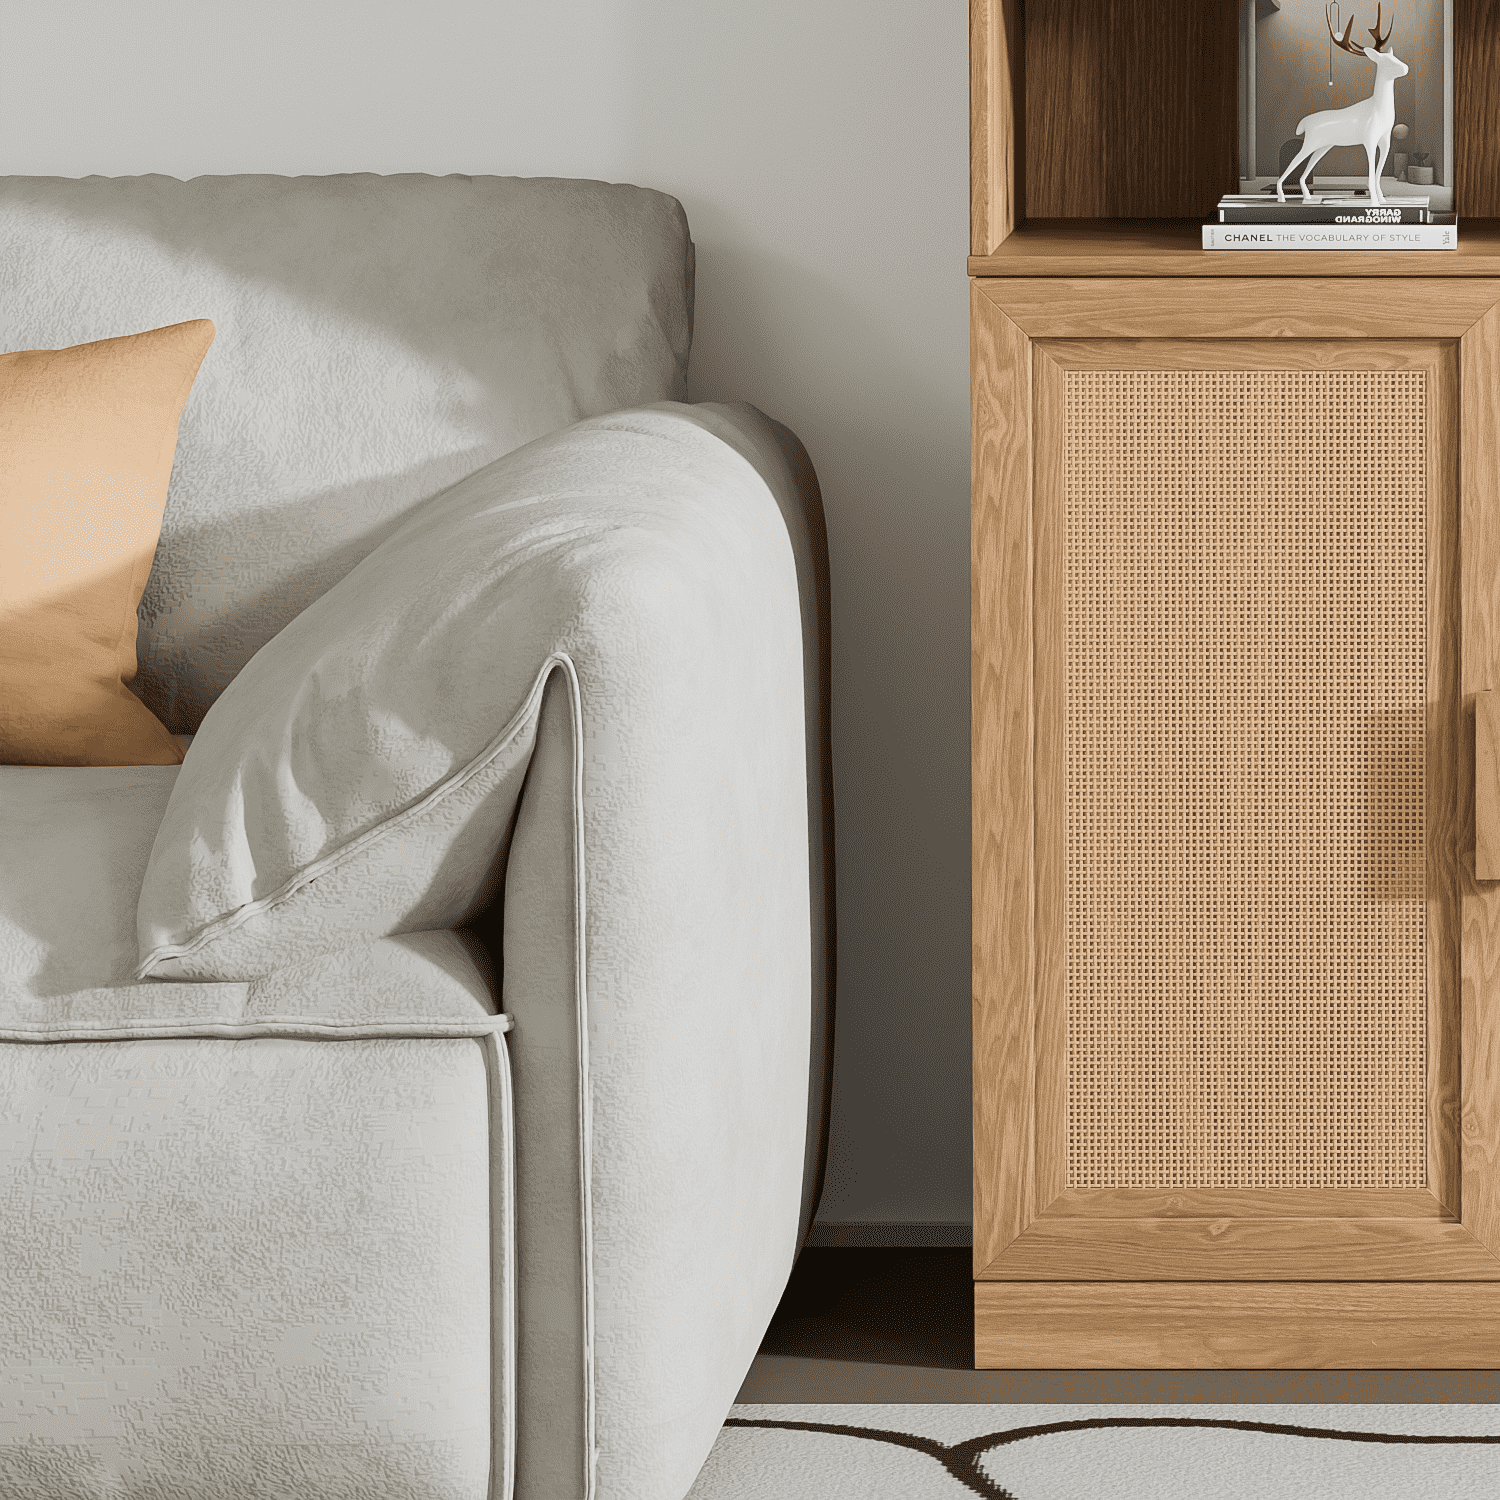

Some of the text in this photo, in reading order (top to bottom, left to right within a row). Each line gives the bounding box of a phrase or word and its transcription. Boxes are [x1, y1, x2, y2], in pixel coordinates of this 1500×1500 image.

[1224, 233, 1421, 243] CHANEL THE VOCABULARY OF STYLE
[1442, 230, 1450, 246] Yale
